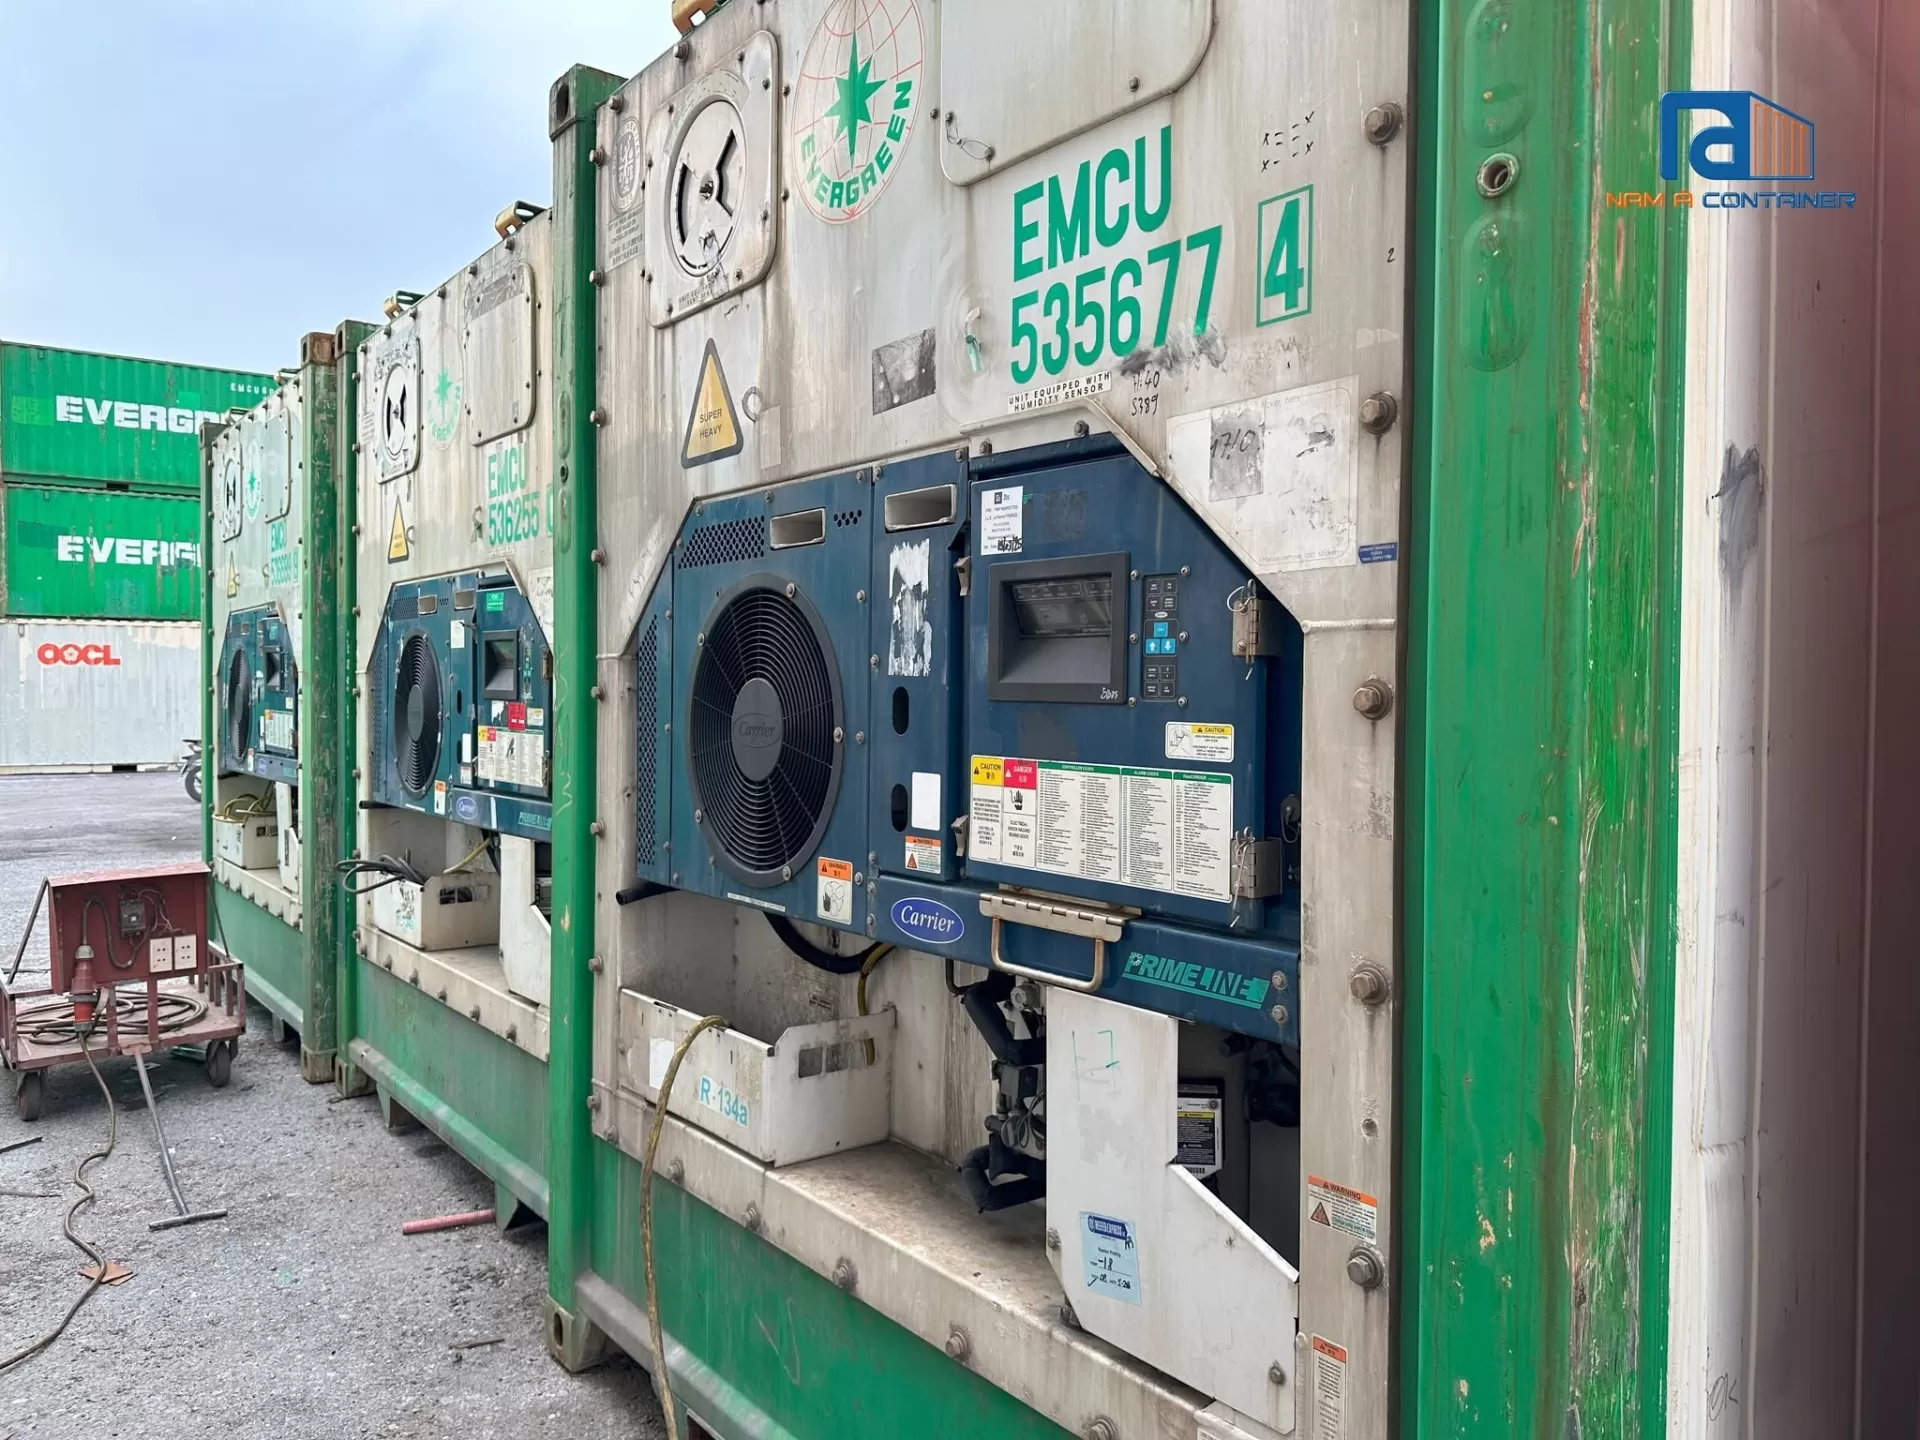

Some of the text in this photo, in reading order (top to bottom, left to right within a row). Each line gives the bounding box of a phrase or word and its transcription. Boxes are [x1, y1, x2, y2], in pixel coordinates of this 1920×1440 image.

[801, 80, 912, 208] EVERGREEN
[1014, 124, 1173, 282] EMCU
[1263, 197, 1304, 311] 4
[1011, 224, 1222, 385] 535677
[1009, 371, 1110, 405] UNIT EQUIPPED WITH
[1014, 383, 1103, 412] HUMIDITY SENSOR
[699, 407, 723, 423] SUPER
[699, 424, 723, 439] HEAVY
[488, 447, 528, 498] EMCU
[489, 490, 540, 546] 536255
[37, 643, 121, 666] OOCL
[1013, 765, 1033, 774] DANGER
[900, 905, 955, 933] Carrier
[699, 1076, 749, 1126] R-134a
[1330, 1182, 1361, 1200] WARNING
